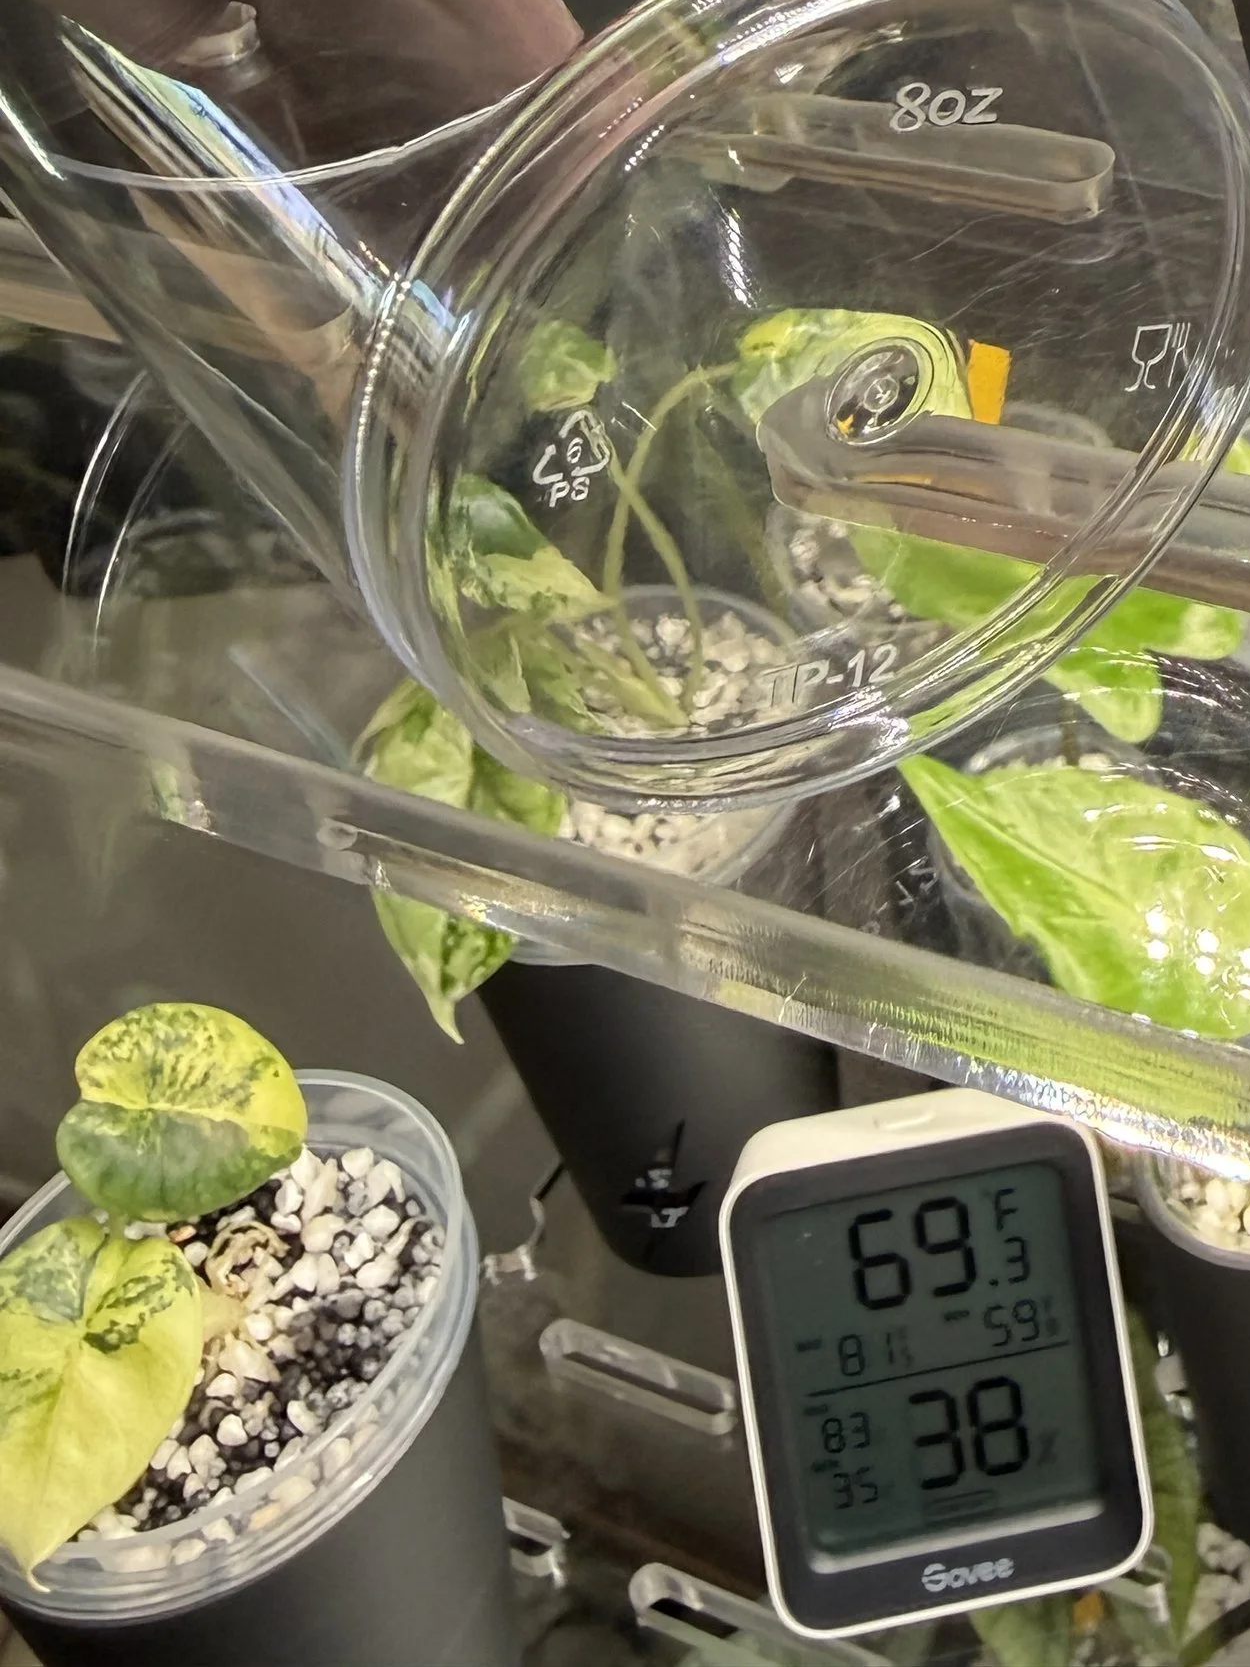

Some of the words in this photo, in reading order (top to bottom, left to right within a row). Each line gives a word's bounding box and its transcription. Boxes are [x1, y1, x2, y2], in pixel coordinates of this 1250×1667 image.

[566, 437, 583, 464] 6
[820, 1410, 871, 1454] 83
[908, 1375, 1031, 1491] 38
[922, 1557, 1016, 1593] Govee
